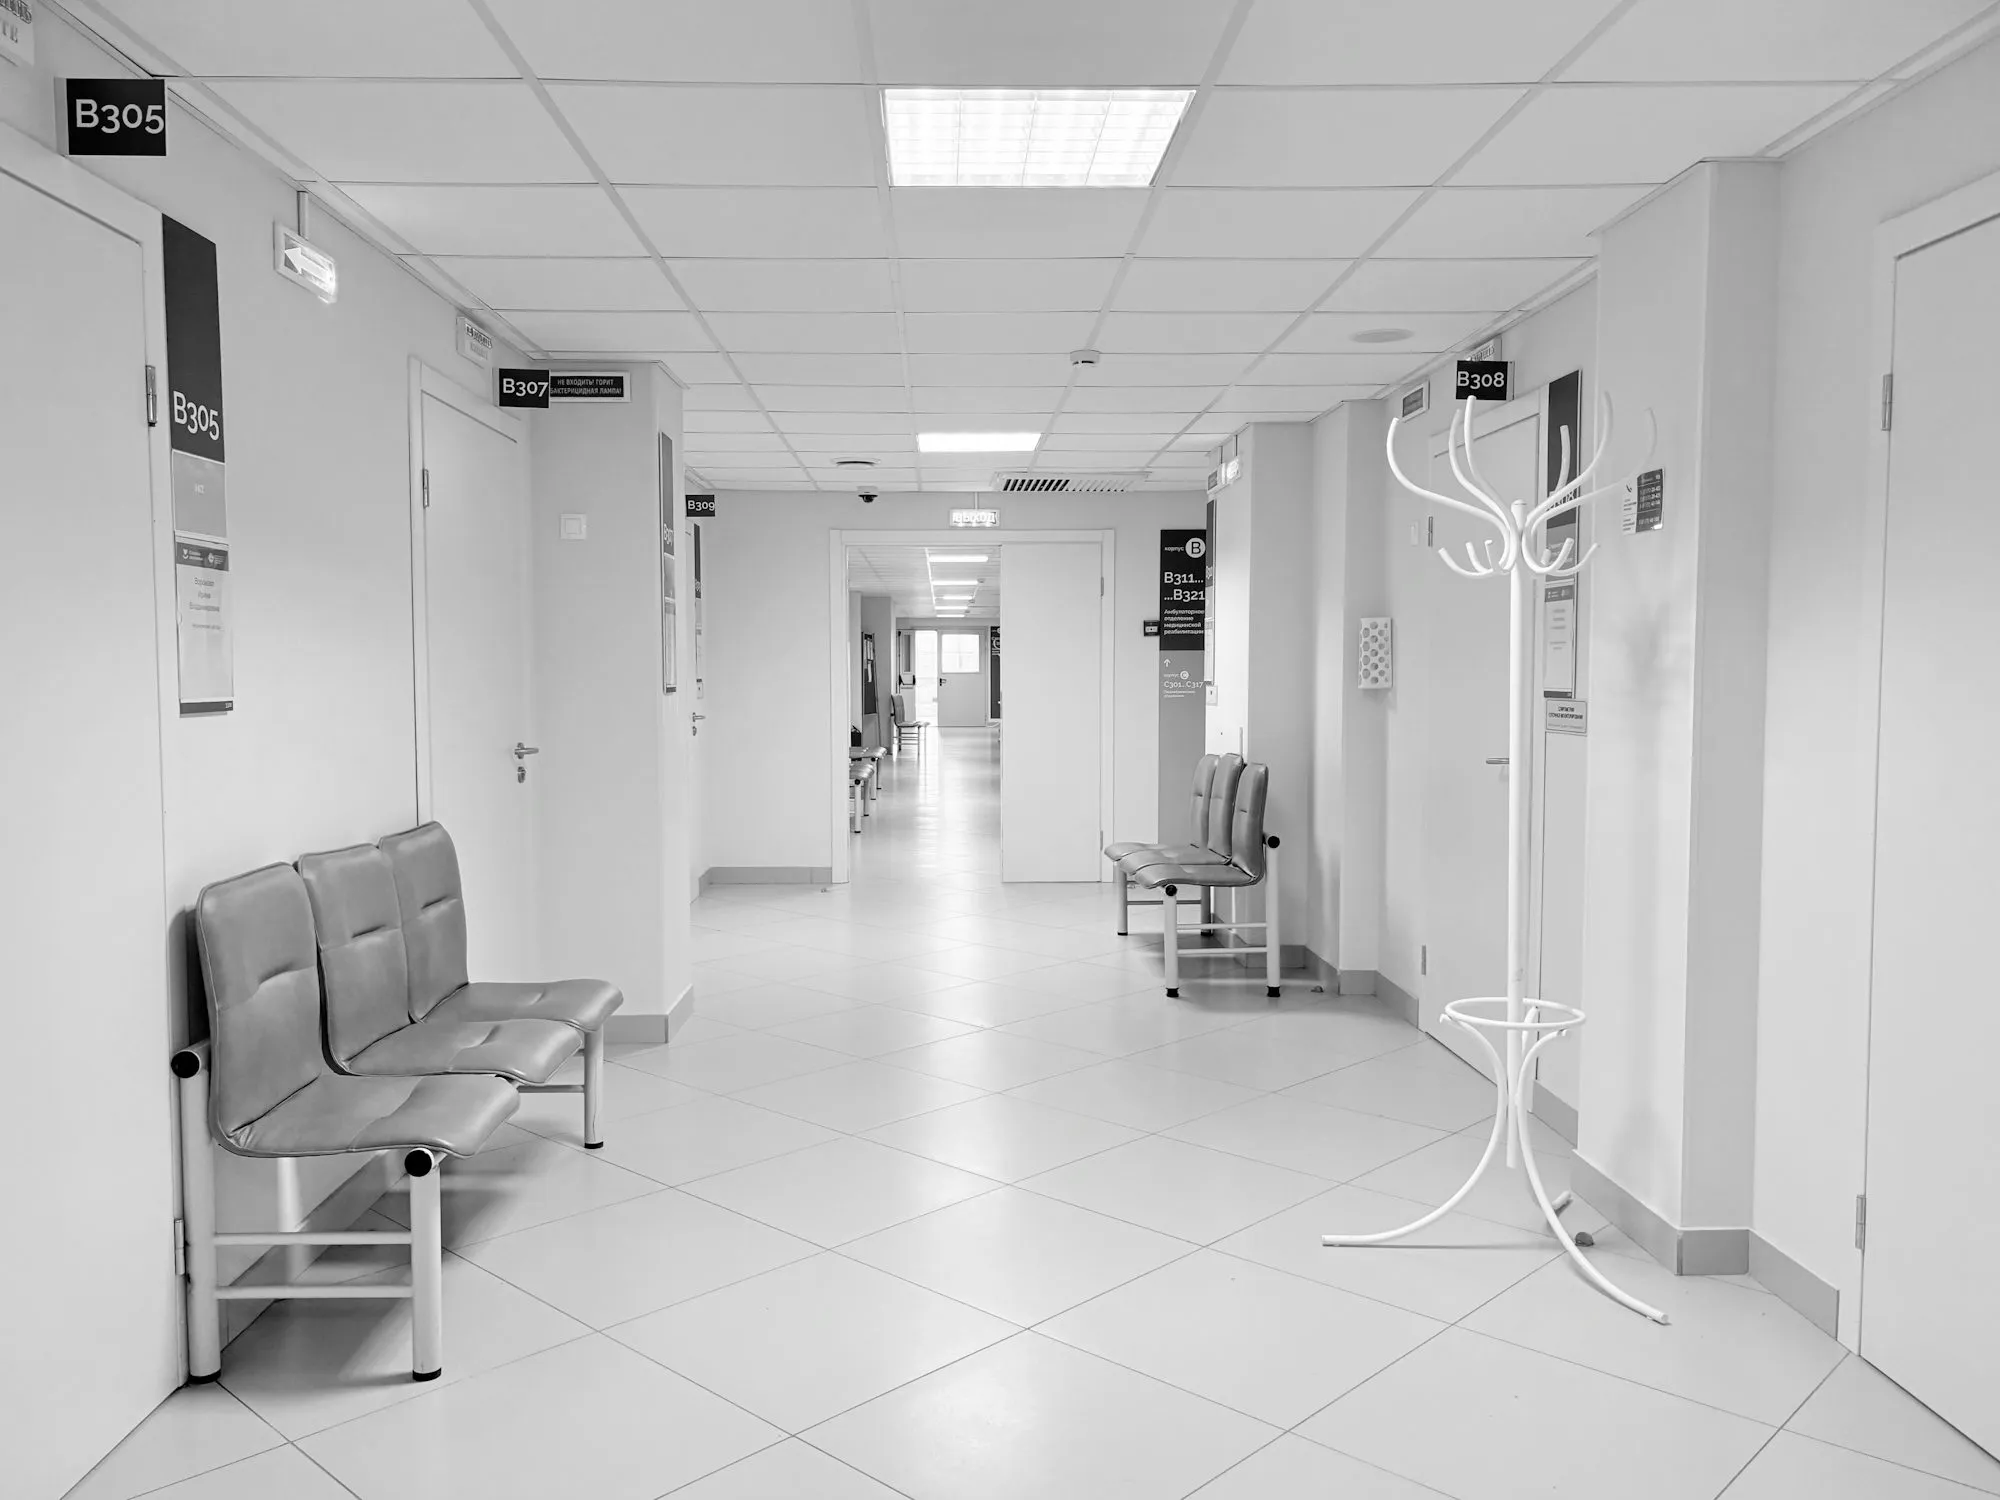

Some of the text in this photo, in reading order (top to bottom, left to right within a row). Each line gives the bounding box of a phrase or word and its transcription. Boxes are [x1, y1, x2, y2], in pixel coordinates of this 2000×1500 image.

[76, 98, 165, 134] B305
[503, 378, 549, 397] B307
[1457, 371, 1504, 390] B308
[173, 390, 220, 440] B305
[688, 500, 715, 511] B309
